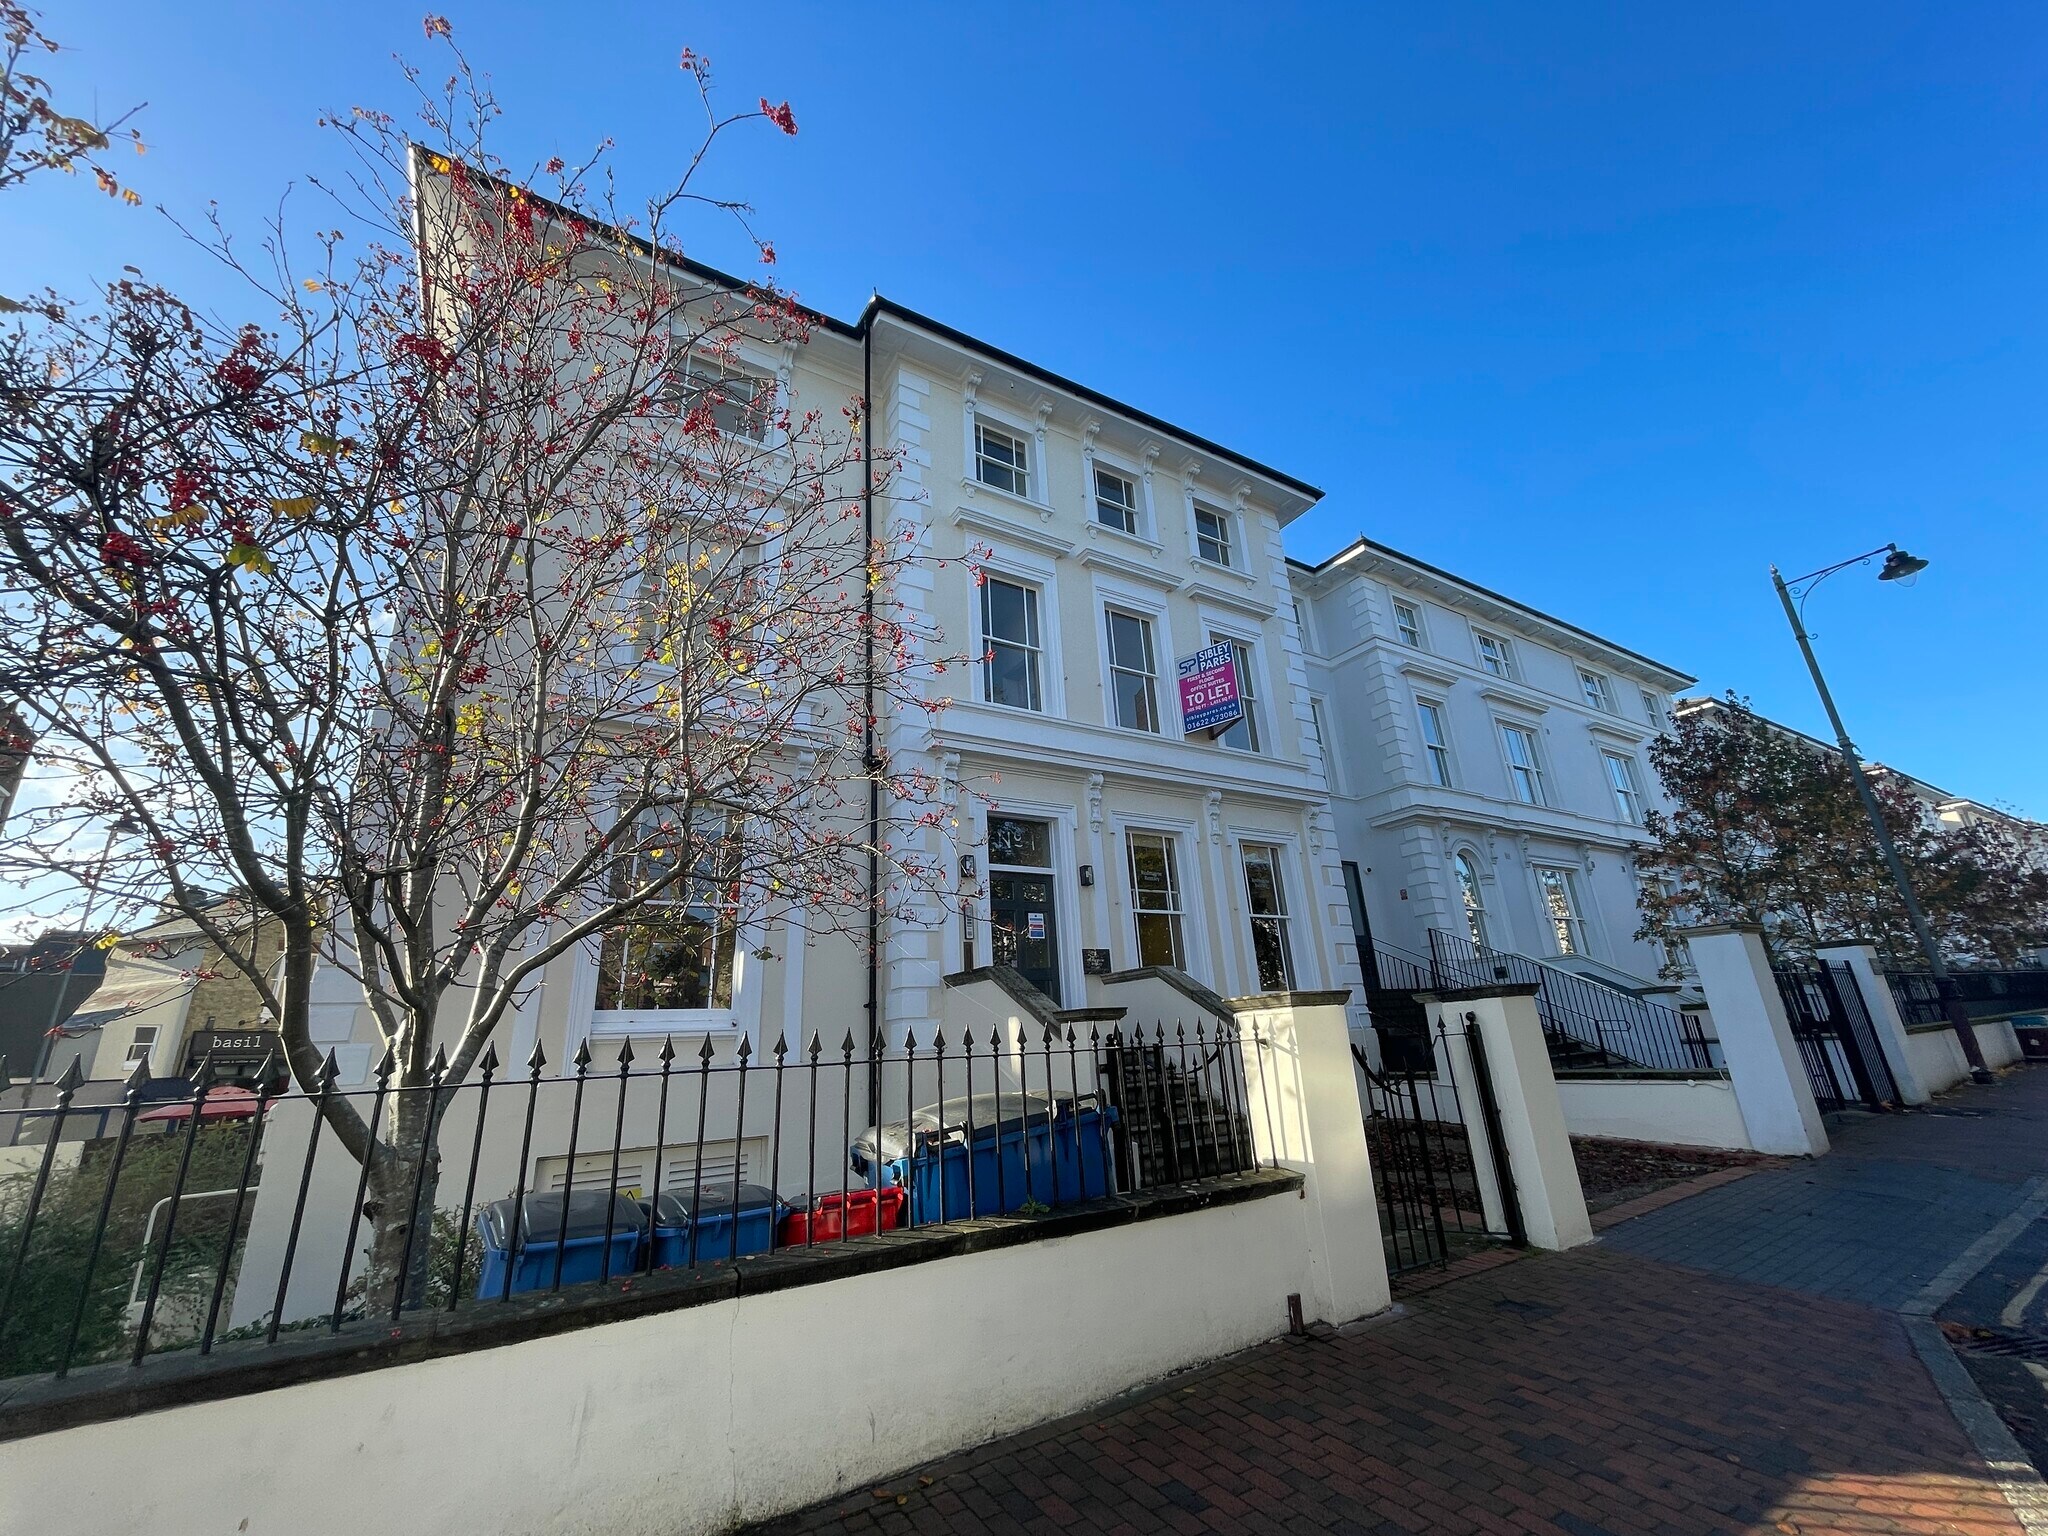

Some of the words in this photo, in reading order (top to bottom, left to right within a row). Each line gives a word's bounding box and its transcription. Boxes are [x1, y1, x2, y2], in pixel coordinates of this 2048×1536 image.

[1199, 643, 1229, 661] SIBLEY
[1200, 653, 1231, 671] PARES
[1187, 674, 1200, 682] FIRST
[1206, 667, 1225, 676] SECOND
[1199, 676, 1214, 684] FLOOR
[1186, 692, 1204, 706] TO
[1208, 682, 1230, 700] LET
[1190, 684, 1206, 692] OFFICE
[1208, 678, 1224, 686] SUITES
[1187, 702, 1235, 721] sibleypares.co.uk
[1187, 718, 1209, 729] 01622
[1211, 710, 1237, 722] 673086
[212, 1036, 260, 1048] basil
